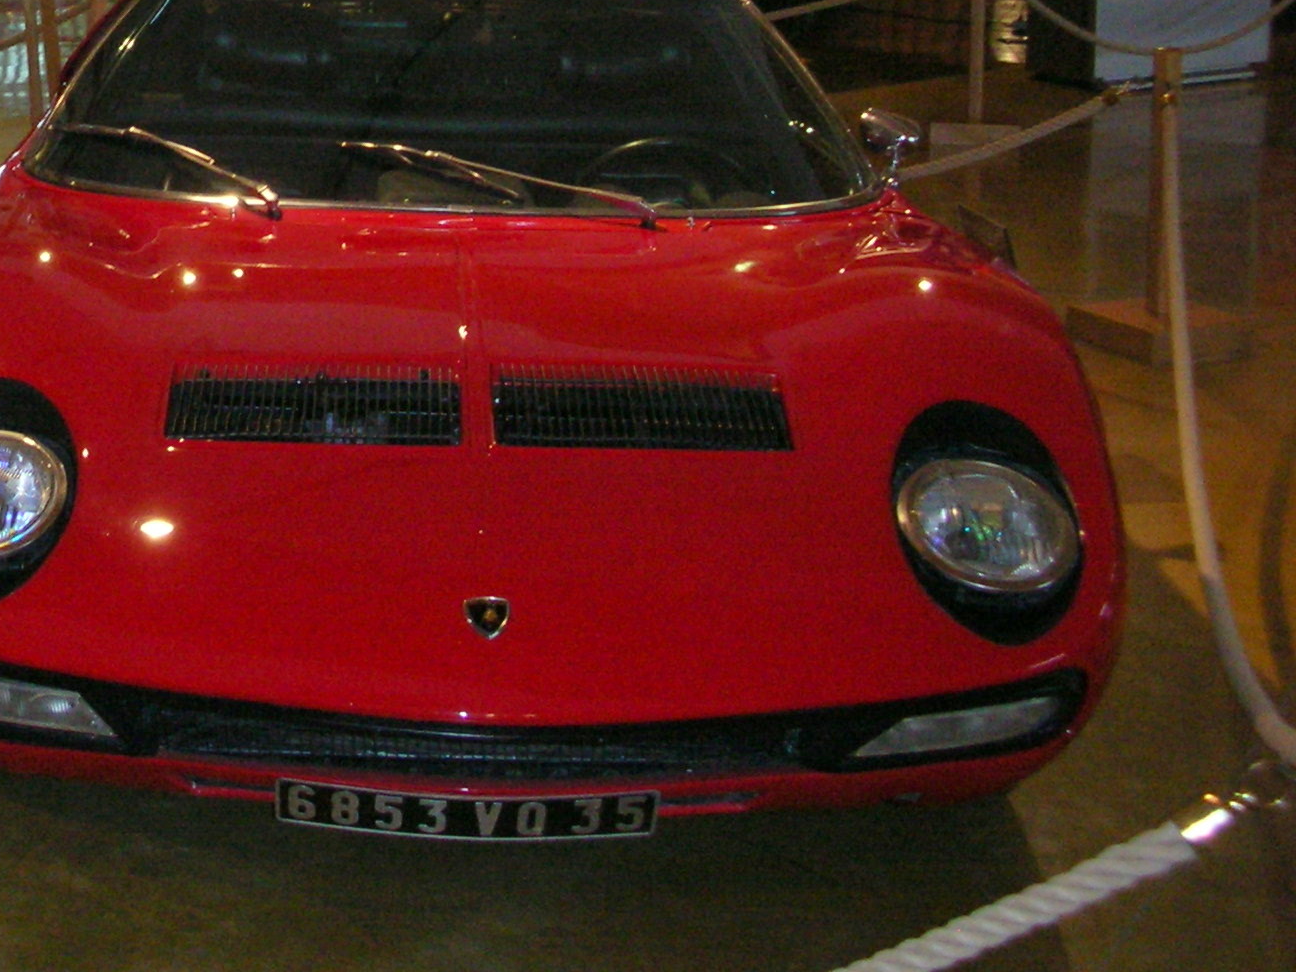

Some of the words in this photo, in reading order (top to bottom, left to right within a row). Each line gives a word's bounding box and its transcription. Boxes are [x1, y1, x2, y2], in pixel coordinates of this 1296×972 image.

[287, 784, 448, 834] 6853
[474, 801, 547, 836] VQ
[570, 795, 647, 832] 35
